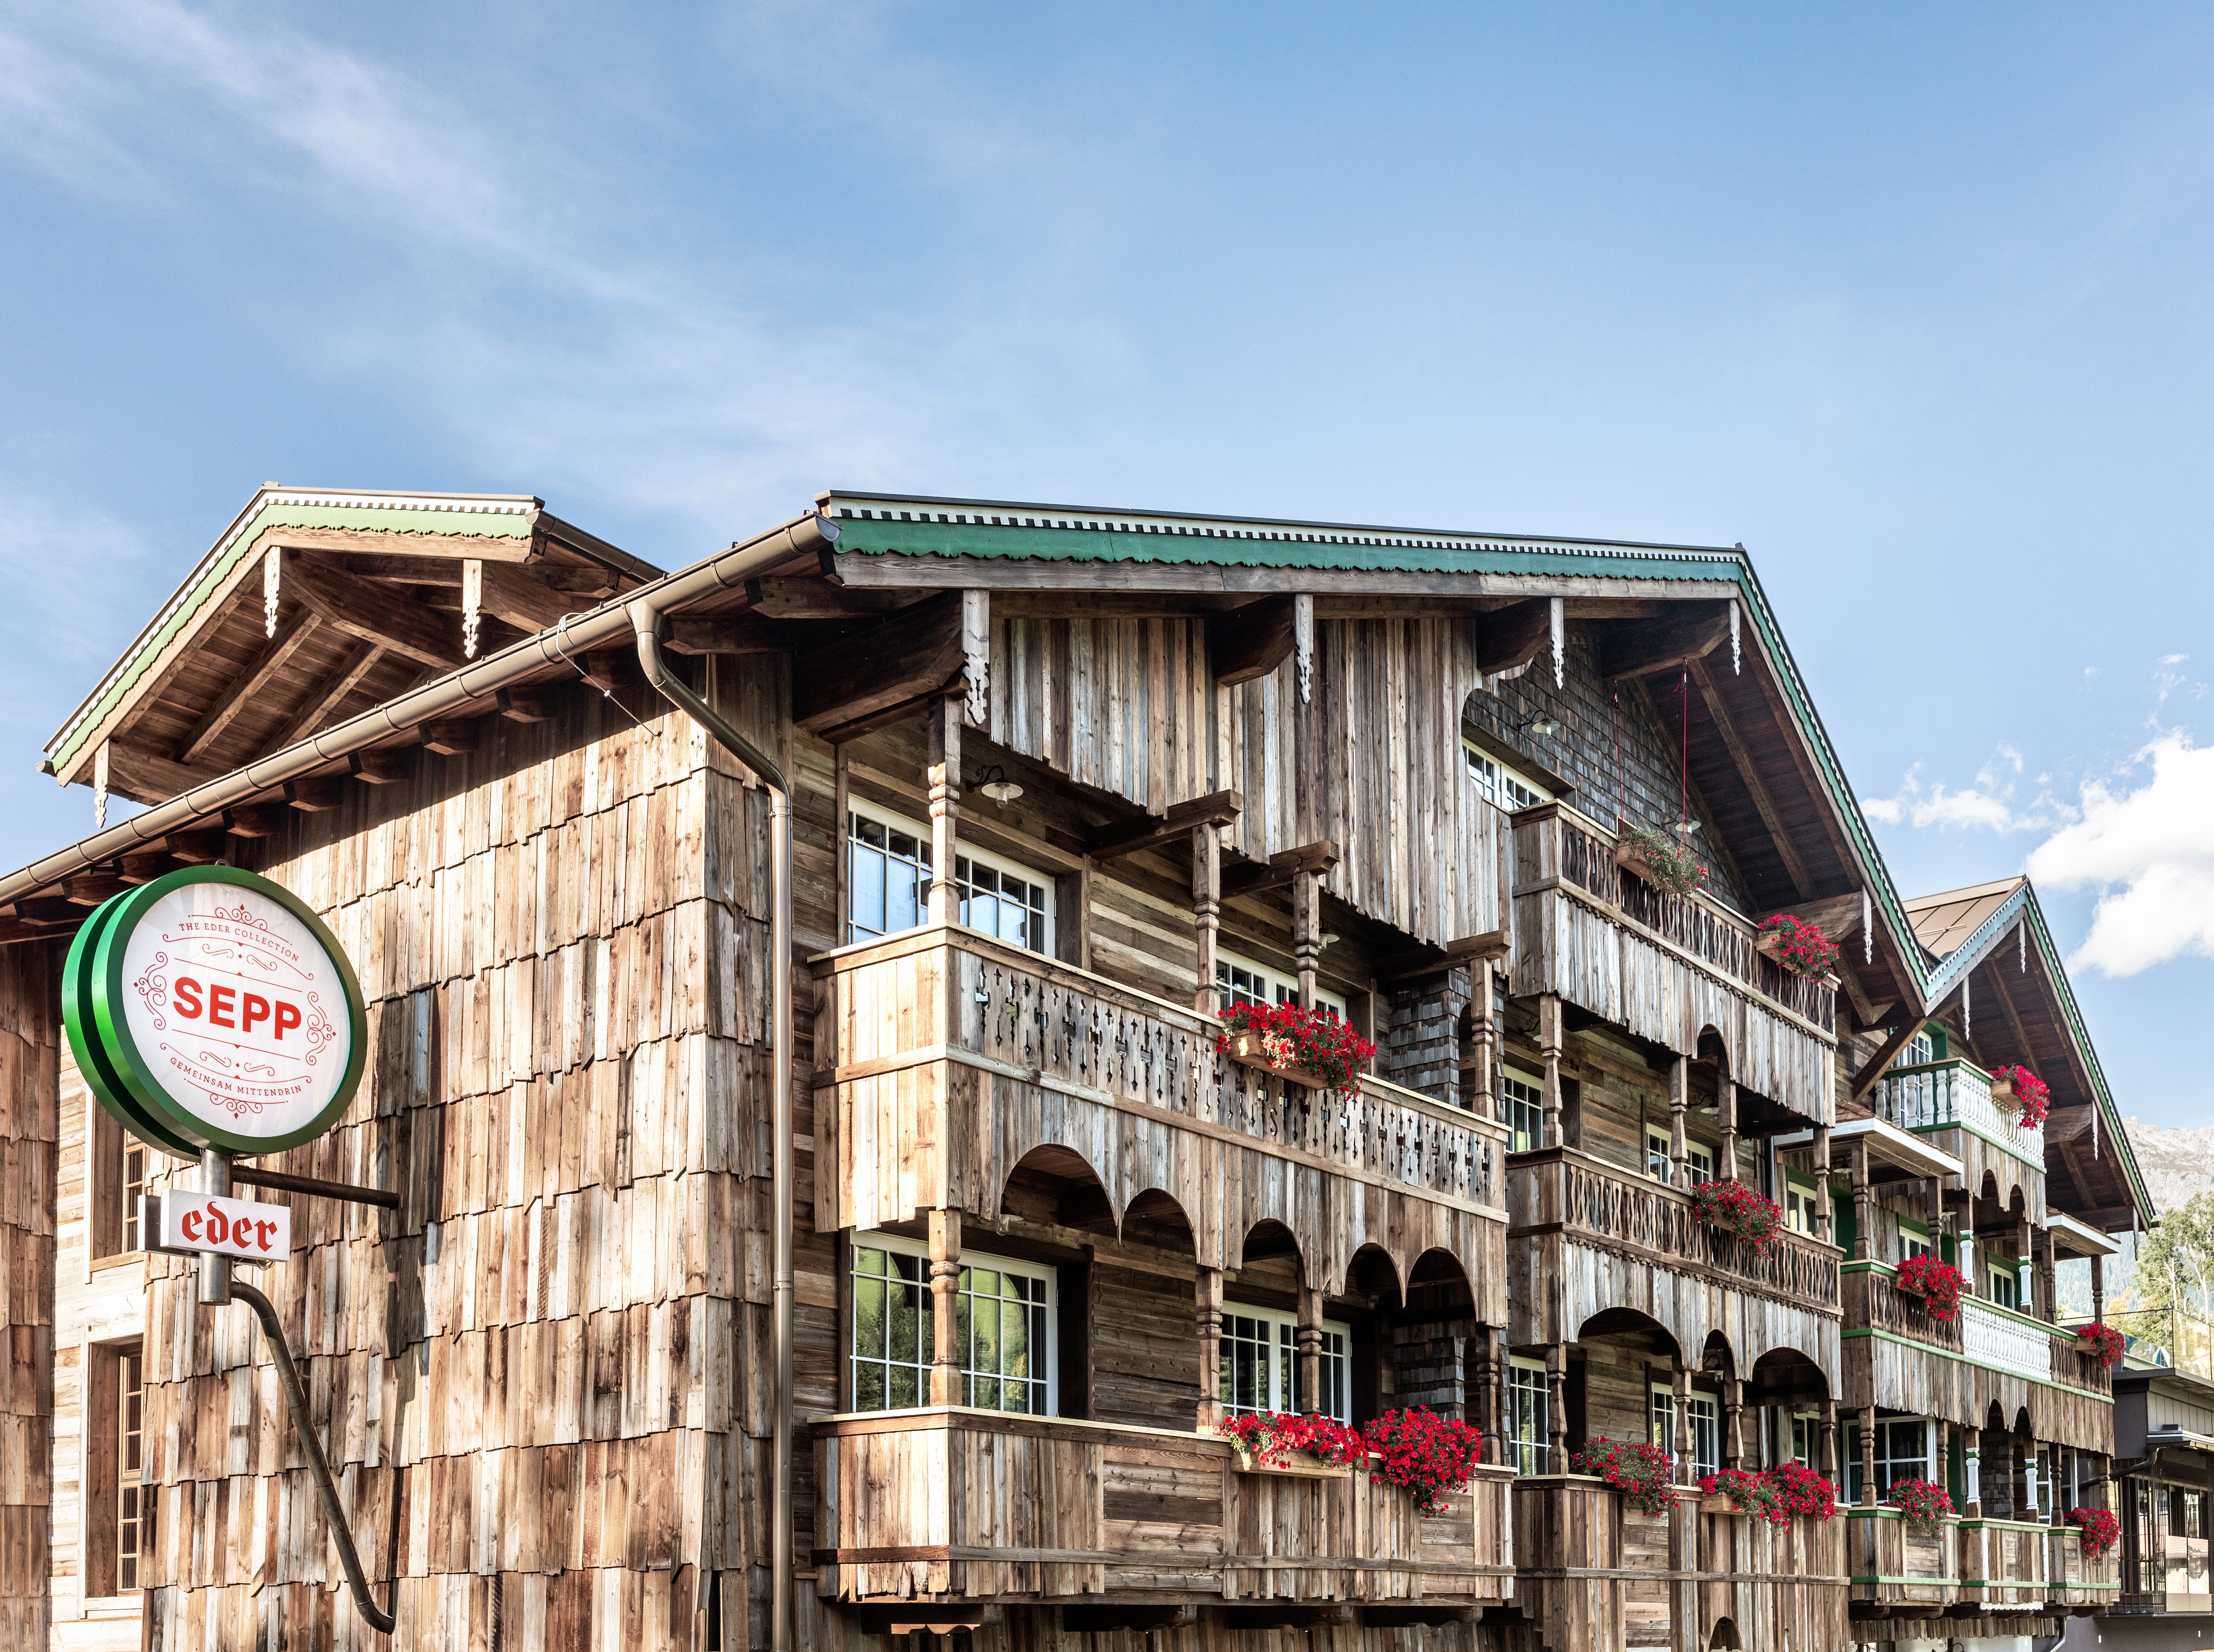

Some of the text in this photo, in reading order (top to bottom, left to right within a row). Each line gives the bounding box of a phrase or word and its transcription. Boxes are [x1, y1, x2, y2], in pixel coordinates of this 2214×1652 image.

[179, 923, 299, 962] THE EDER COLLECTION
[173, 976, 302, 1040] SEPP
[170, 1057, 302, 1097] GEMEINSAM MITTENDRIN
[181, 1201, 278, 1252] eder
